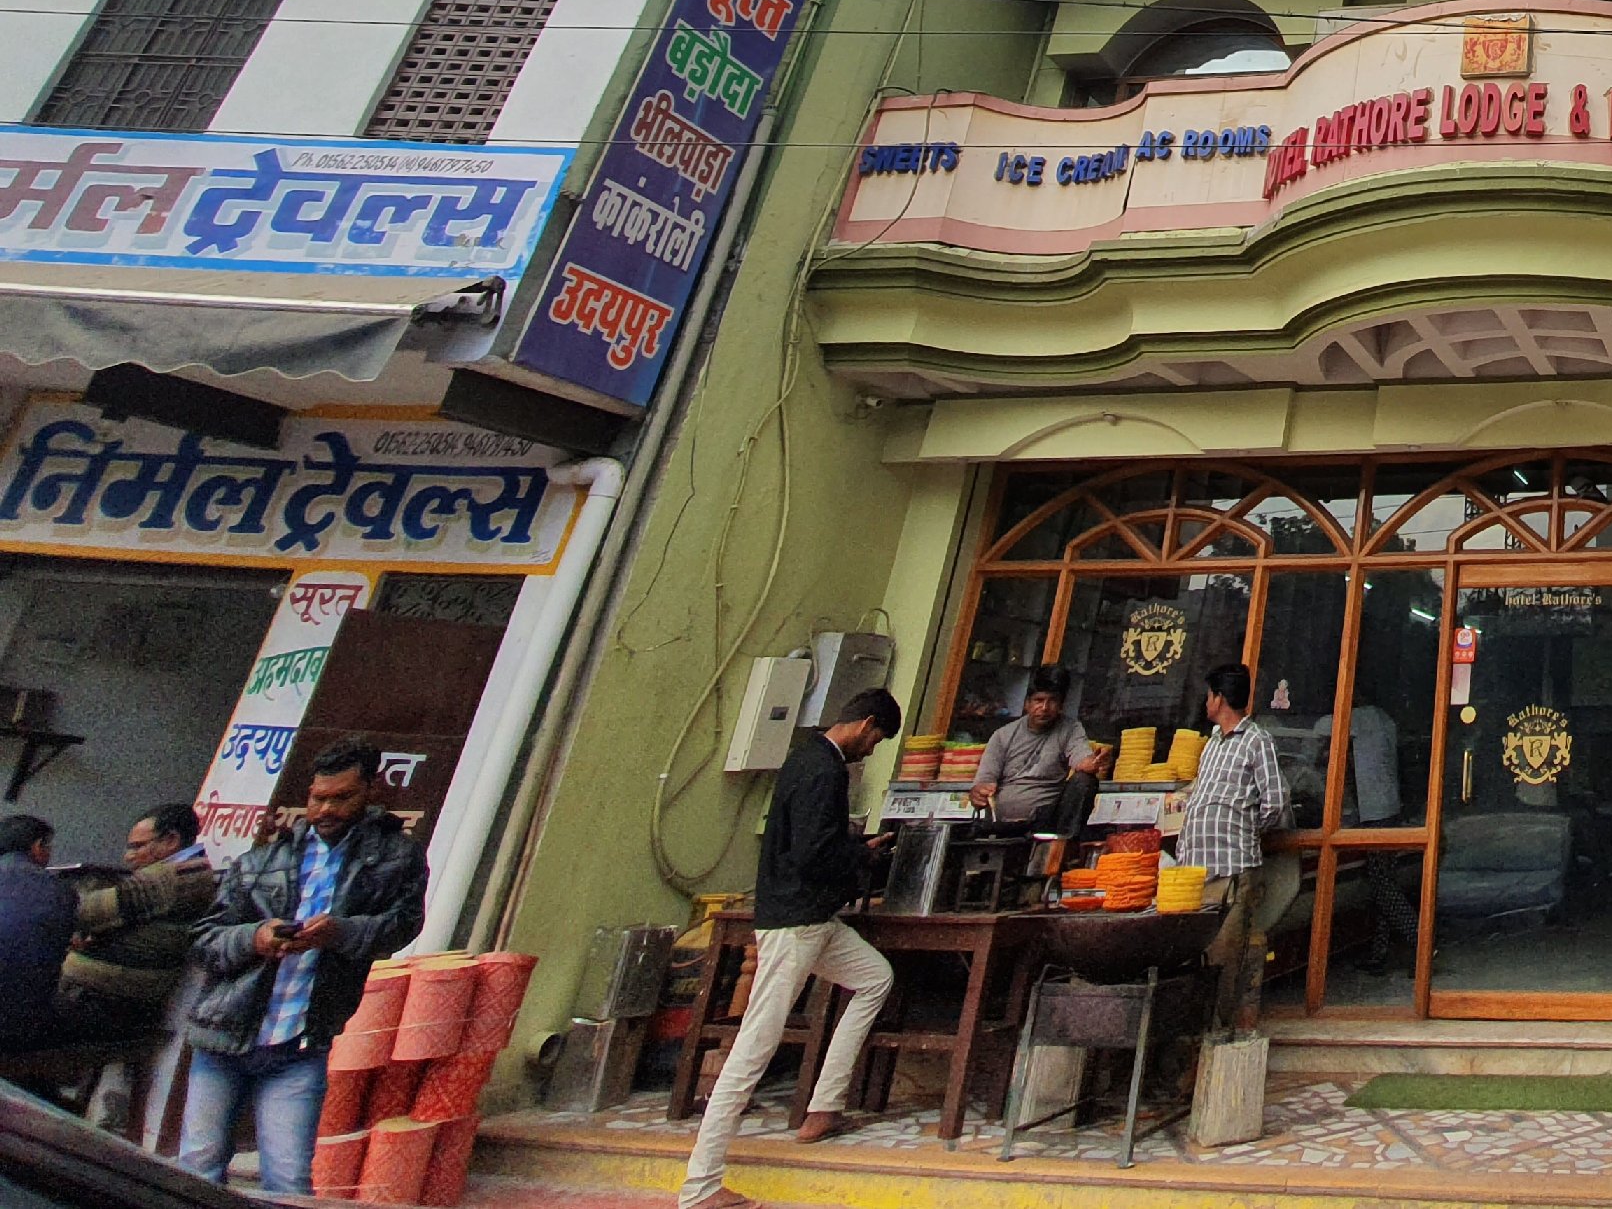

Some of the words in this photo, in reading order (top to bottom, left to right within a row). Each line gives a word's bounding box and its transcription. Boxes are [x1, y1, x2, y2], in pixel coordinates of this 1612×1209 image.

[630, 89, 735, 202] भीलवाड़ा
[859, 142, 962, 176] SWEETS
[995, 152, 1046, 186] ICE
[1056, 144, 1130, 186] CREAM
[1135, 130, 1176, 161] AC
[1180, 125, 1271, 160] ROOMS
[1311, 87, 1432, 168] RATHORE
[1440, 82, 1550, 138] LODGE
[1569, 83, 1591, 136] &
[183, 148, 537, 255] ट्रेवल्स
[593, 176, 706, 272] कांकरोली
[550, 261, 673, 371] उदयपुर
[289, 582, 363, 625] सूरत
[246, 646, 331, 701] अहमदाब
[220, 723, 299, 775] उदयपु
